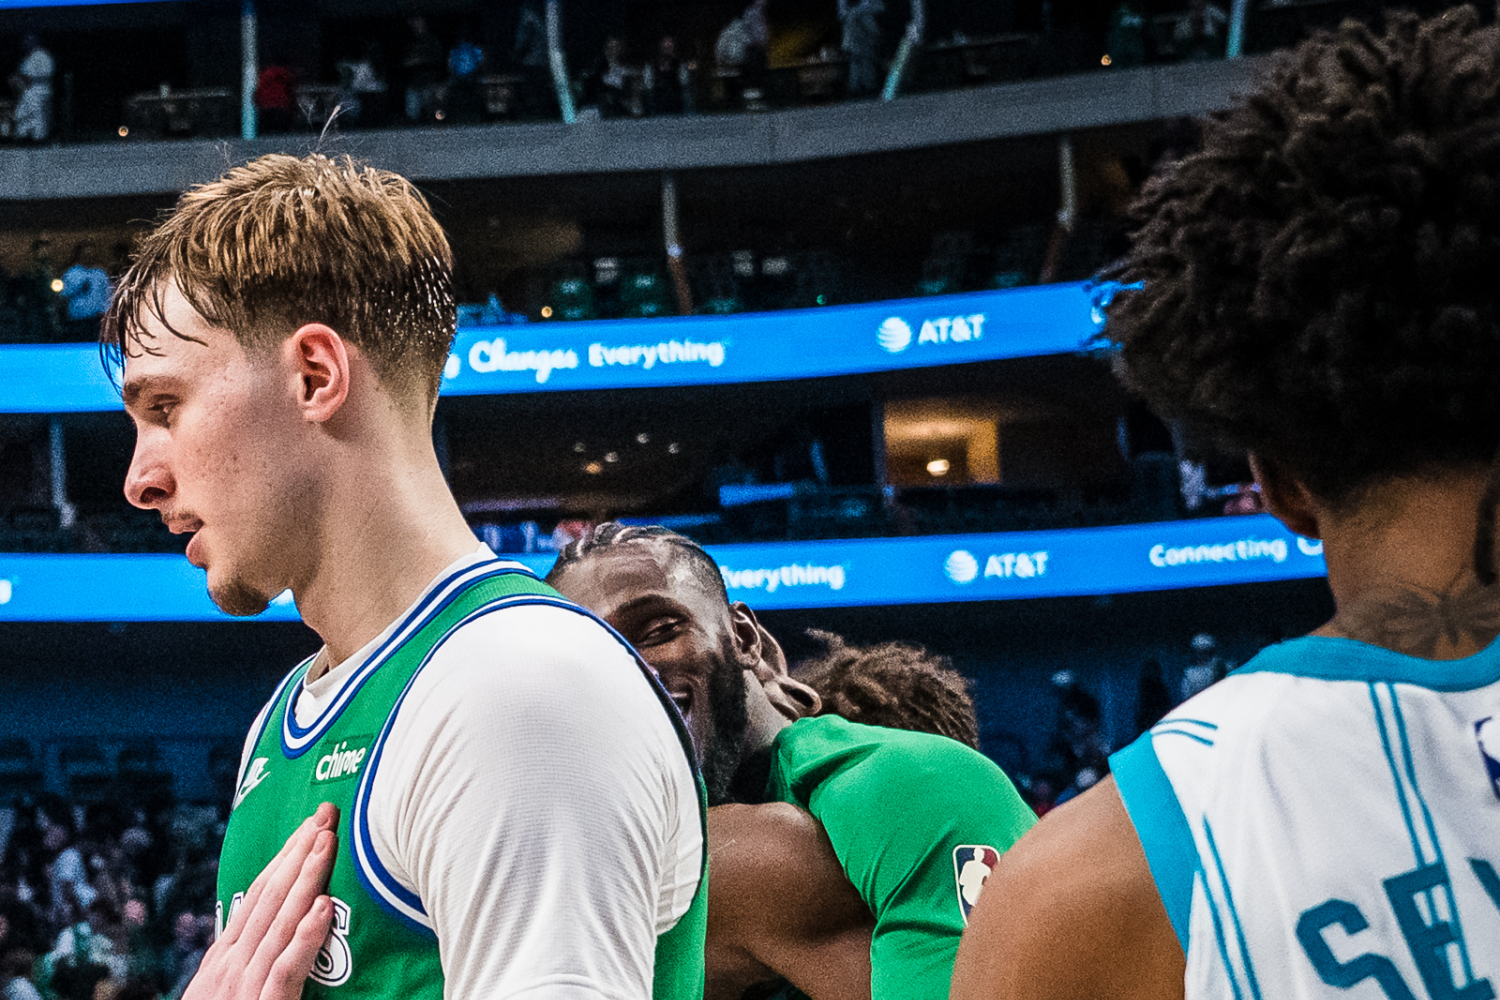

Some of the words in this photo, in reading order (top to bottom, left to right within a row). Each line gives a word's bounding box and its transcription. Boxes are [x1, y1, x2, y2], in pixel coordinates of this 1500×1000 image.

[918, 313, 986, 344] AT&T
[468, 337, 579, 384] Changes
[588, 340, 725, 368] Everything
[983, 551, 1049, 579] AT&T
[1149, 538, 1288, 567] Connecting
[315, 741, 367, 781] chime
